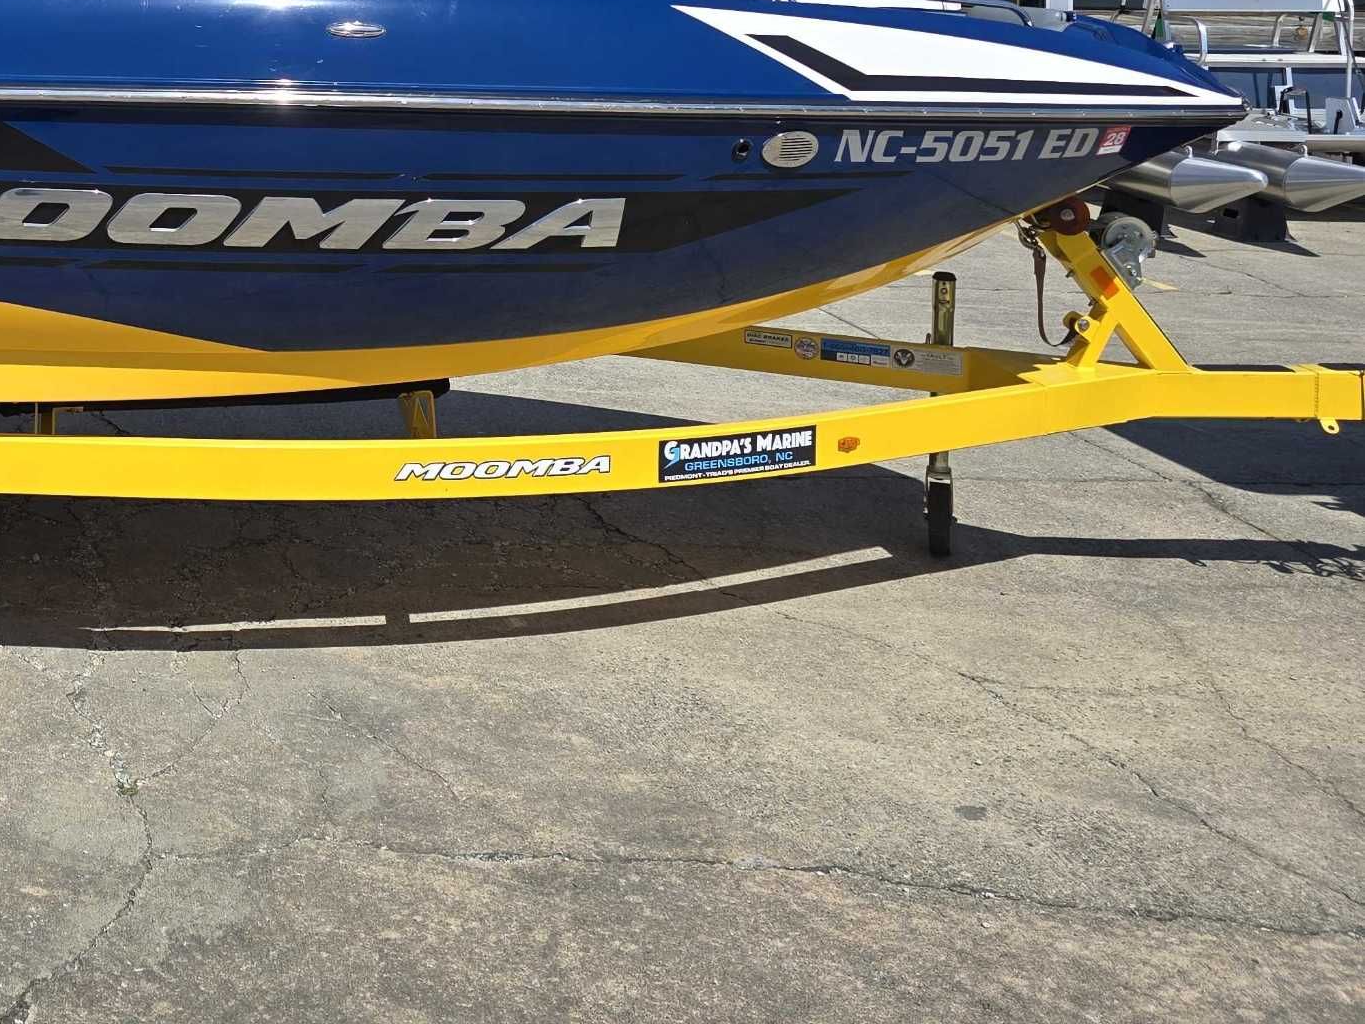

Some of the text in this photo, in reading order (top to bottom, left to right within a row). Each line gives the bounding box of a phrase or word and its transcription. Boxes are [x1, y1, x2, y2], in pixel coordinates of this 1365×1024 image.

[834, 127, 1099, 163] NC-5051 ED
[664, 430, 813, 468] GRANDPA'S MARINE
[684, 451, 793, 472] GREENSBORO, NC
[394, 455, 611, 482] MOOMBA
[764, 463, 783, 471] BOAT
